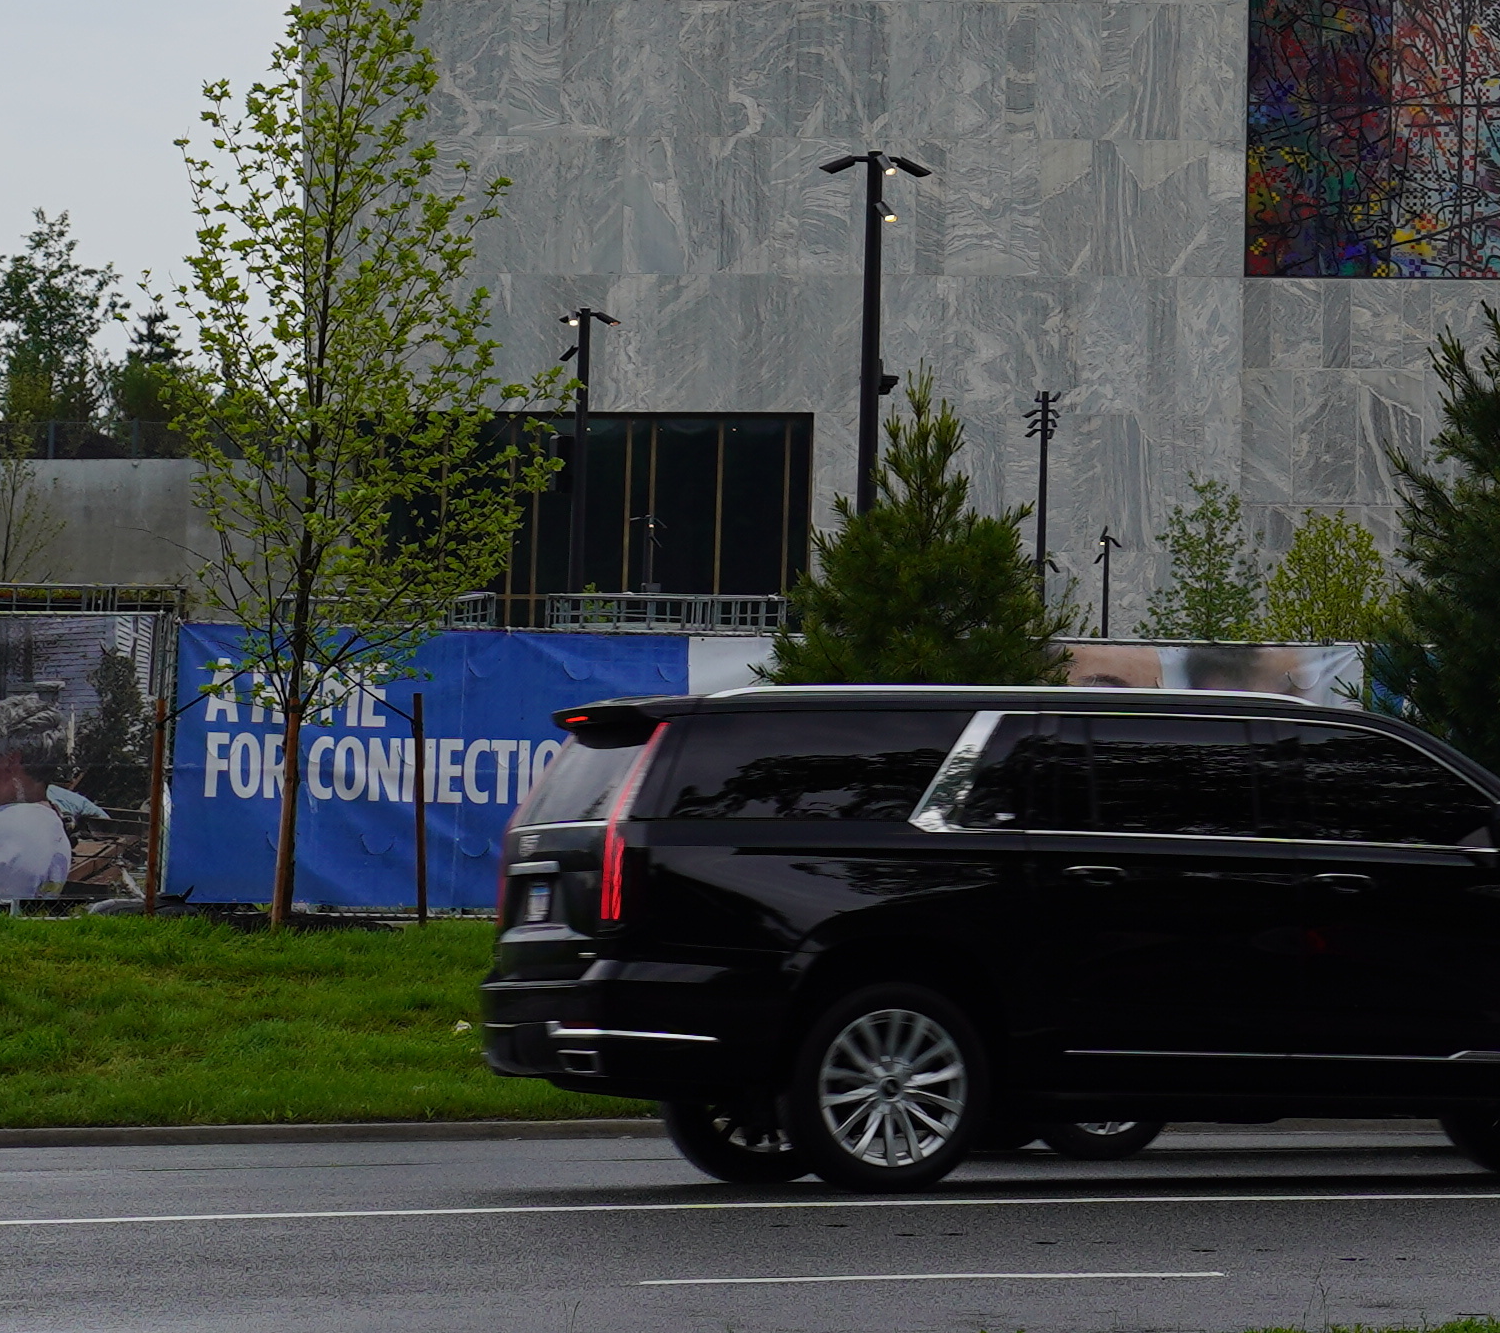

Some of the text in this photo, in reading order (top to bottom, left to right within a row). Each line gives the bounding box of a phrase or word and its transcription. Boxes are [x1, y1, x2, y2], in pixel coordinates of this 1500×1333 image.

[204, 657, 240, 723] A
[204, 731, 564, 806] FOR CONNECTIO
